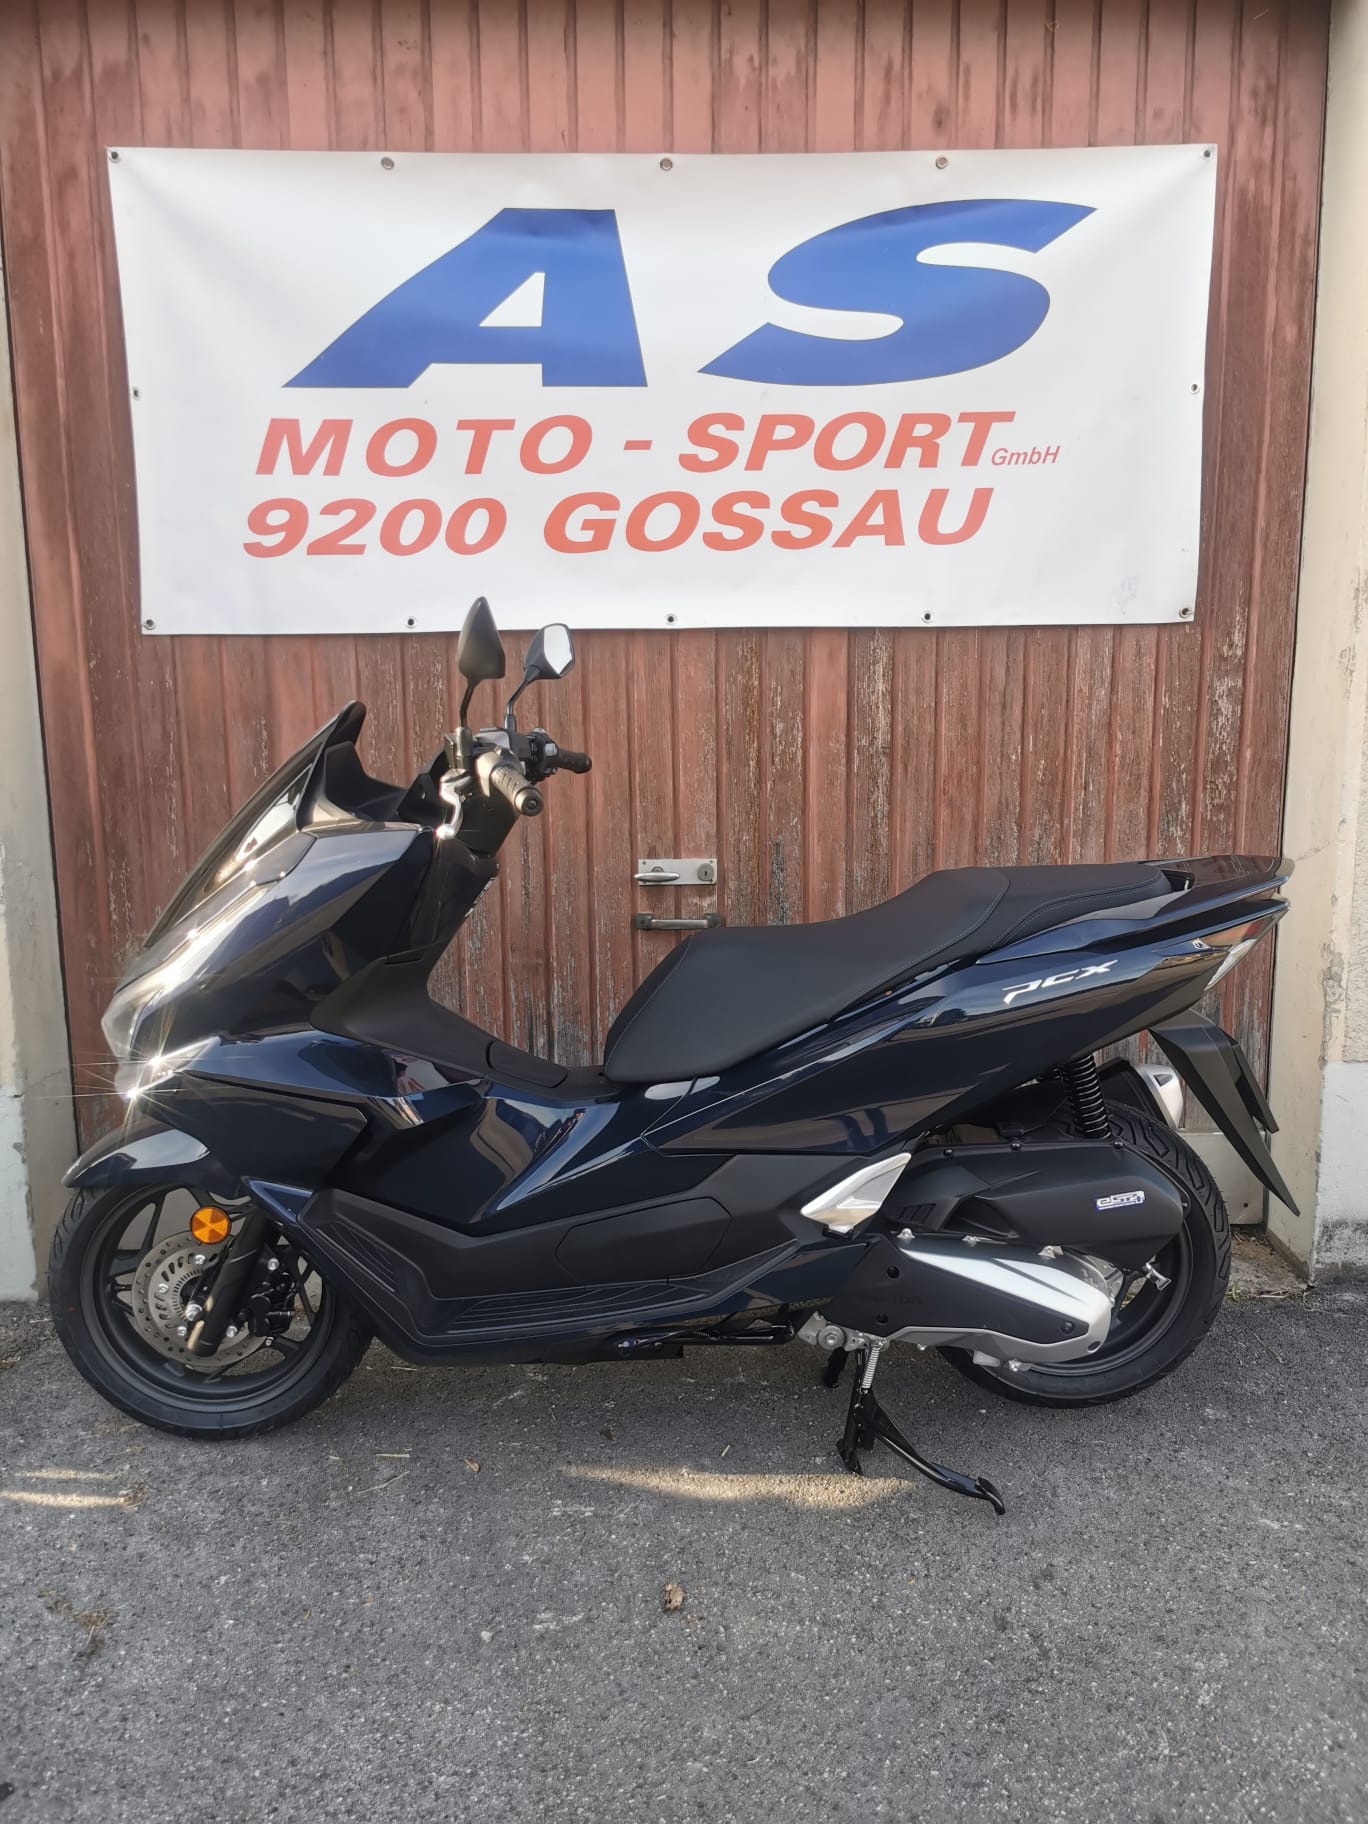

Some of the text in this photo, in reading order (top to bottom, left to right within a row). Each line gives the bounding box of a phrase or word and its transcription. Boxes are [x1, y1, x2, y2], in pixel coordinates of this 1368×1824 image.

[255, 414, 593, 478] MOTO
[677, 410, 1016, 474] SPORT
[990, 445, 1060, 467] GmbH
[242, 487, 994, 559] 9200 GOSSAU
[1001, 959, 1119, 1006] PCX
